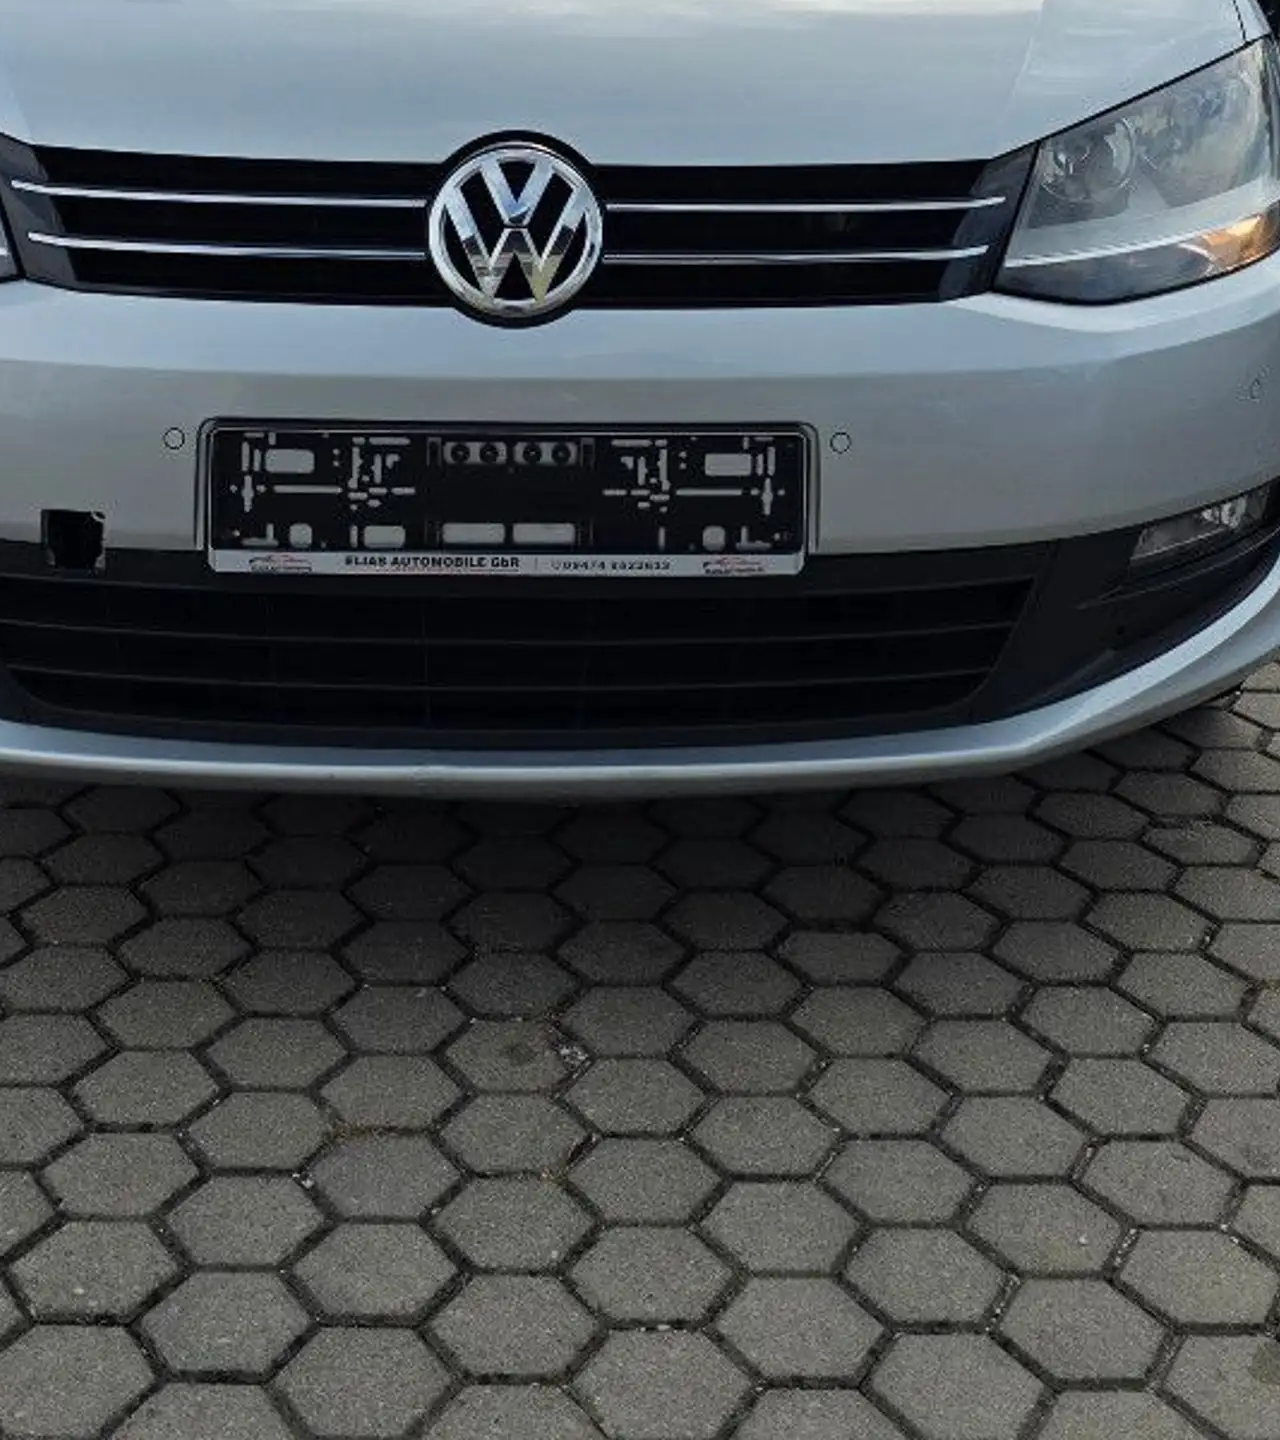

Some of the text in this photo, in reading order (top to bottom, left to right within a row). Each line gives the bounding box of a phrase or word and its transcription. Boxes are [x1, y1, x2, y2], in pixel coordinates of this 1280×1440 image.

[345, 556, 520, 569] ELIAS AUTOMOBILE GbR
